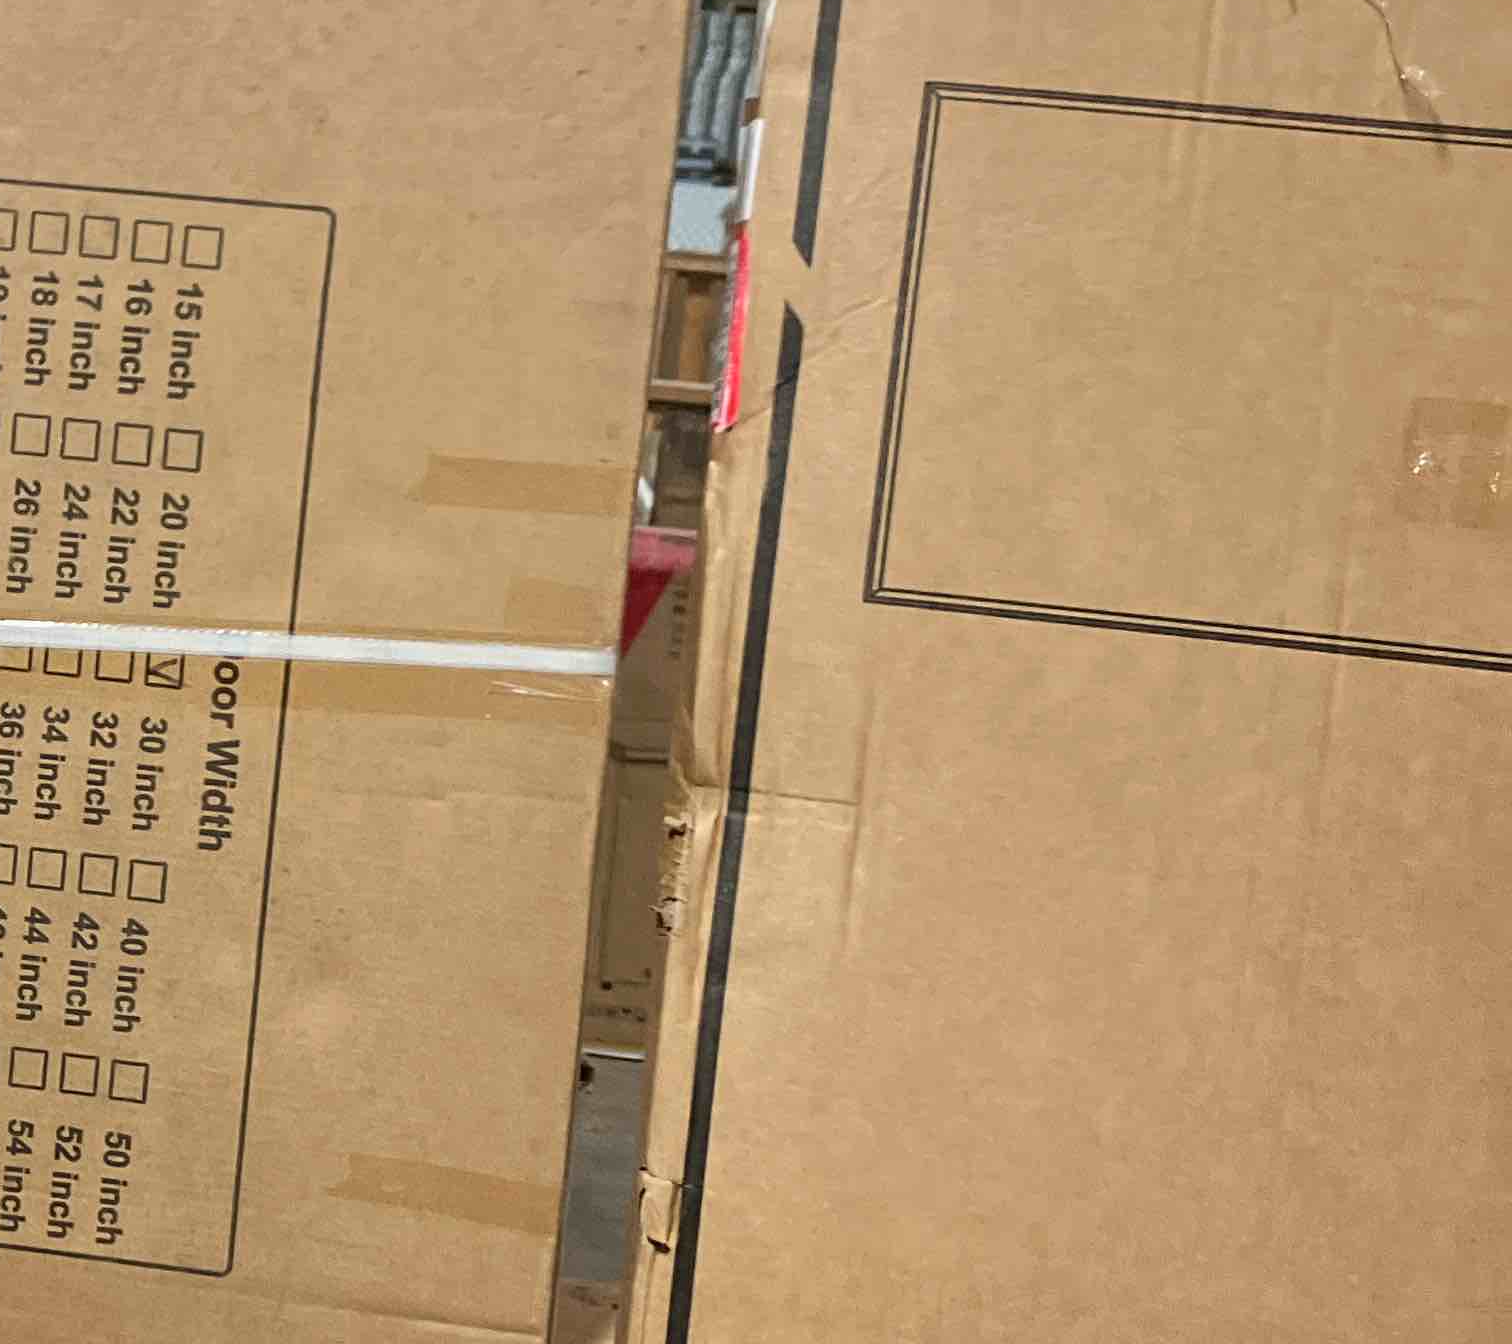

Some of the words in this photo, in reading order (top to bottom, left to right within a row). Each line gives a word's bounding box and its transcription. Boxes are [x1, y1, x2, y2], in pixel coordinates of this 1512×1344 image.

[32, 272, 59, 306] 18
[77, 275, 104, 311] 17
[125, 280, 154, 315] 16
[175, 284, 204, 320] 15
[24, 318, 56, 386] inch
[68, 322, 100, 390] inch
[118, 326, 150, 394] inch
[167, 331, 200, 399] inch
[14, 478, 41, 516] 26
[62, 483, 90, 520] 24
[111, 488, 140, 526] 22
[160, 493, 189, 530] 20
[6, 527, 37, 593] inch
[55, 532, 87, 598] inch
[104, 536, 136, 603] inch
[153, 541, 185, 608] inch
[42, 706, 70, 743] 34
[210, 655, 244, 730] oor
[90, 712, 118, 748] 32
[139, 717, 168, 753] 30
[34, 753, 66, 820] inch
[83, 759, 115, 825] inch
[132, 764, 164, 830] inch
[197, 739, 241, 852] Width
[22, 907, 51, 944] 44
[72, 912, 100, 950] 42
[120, 918, 149, 955] 40
[16, 954, 47, 1020] inch
[64, 960, 96, 1026] inch
[113, 966, 144, 1032] inch
[6, 1119, 34, 1155] 54
[54, 1125, 83, 1162] 52
[103, 1132, 131, 1167] 50
[47, 1172, 79, 1238] inch
[96, 1178, 128, 1244] inch
